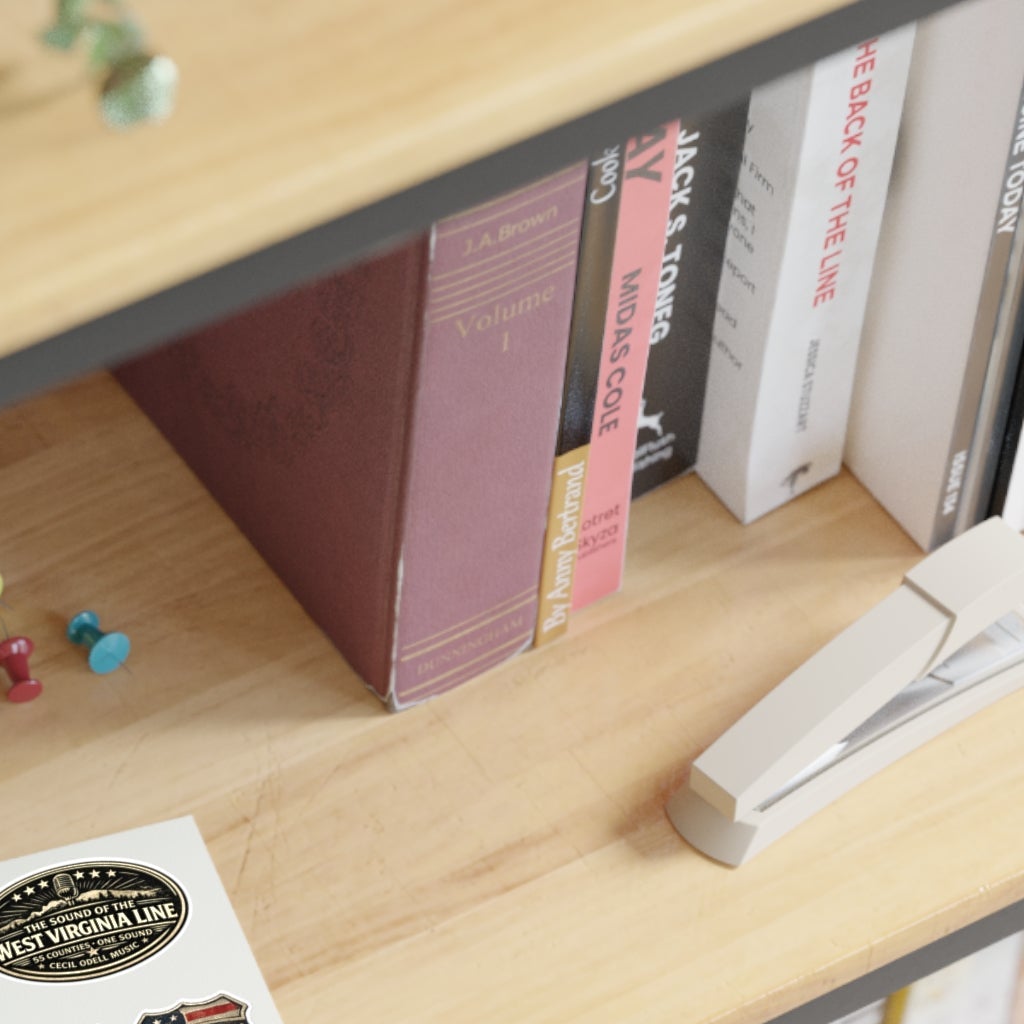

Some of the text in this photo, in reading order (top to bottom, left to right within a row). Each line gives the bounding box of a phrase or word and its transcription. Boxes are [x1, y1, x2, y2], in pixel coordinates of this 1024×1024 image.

[841, 78, 872, 154] BACK
[590, 144, 621, 204] Cook
[669, 129, 701, 212] JACK
[835, 156, 859, 191] OF
[996, 159, 1024, 235] TODAY
[824, 194, 852, 251] THE
[812, 249, 842, 309] LINE
[455, 285, 556, 338] Volume
[599, 267, 643, 437] MIDAS COLE
[552, 461, 586, 551] Bertrand
[542, 602, 572, 633] By
[25, 900, 136, 934] THE SOUND OF THE
[47, 914, 133, 946] VIRGINIA
[133, 902, 179, 925] LINE
[32, 927, 154, 965] 55 COUNTIES ONE SOUND
[49, 941, 141, 970] CECIL ODELL MUSIC
